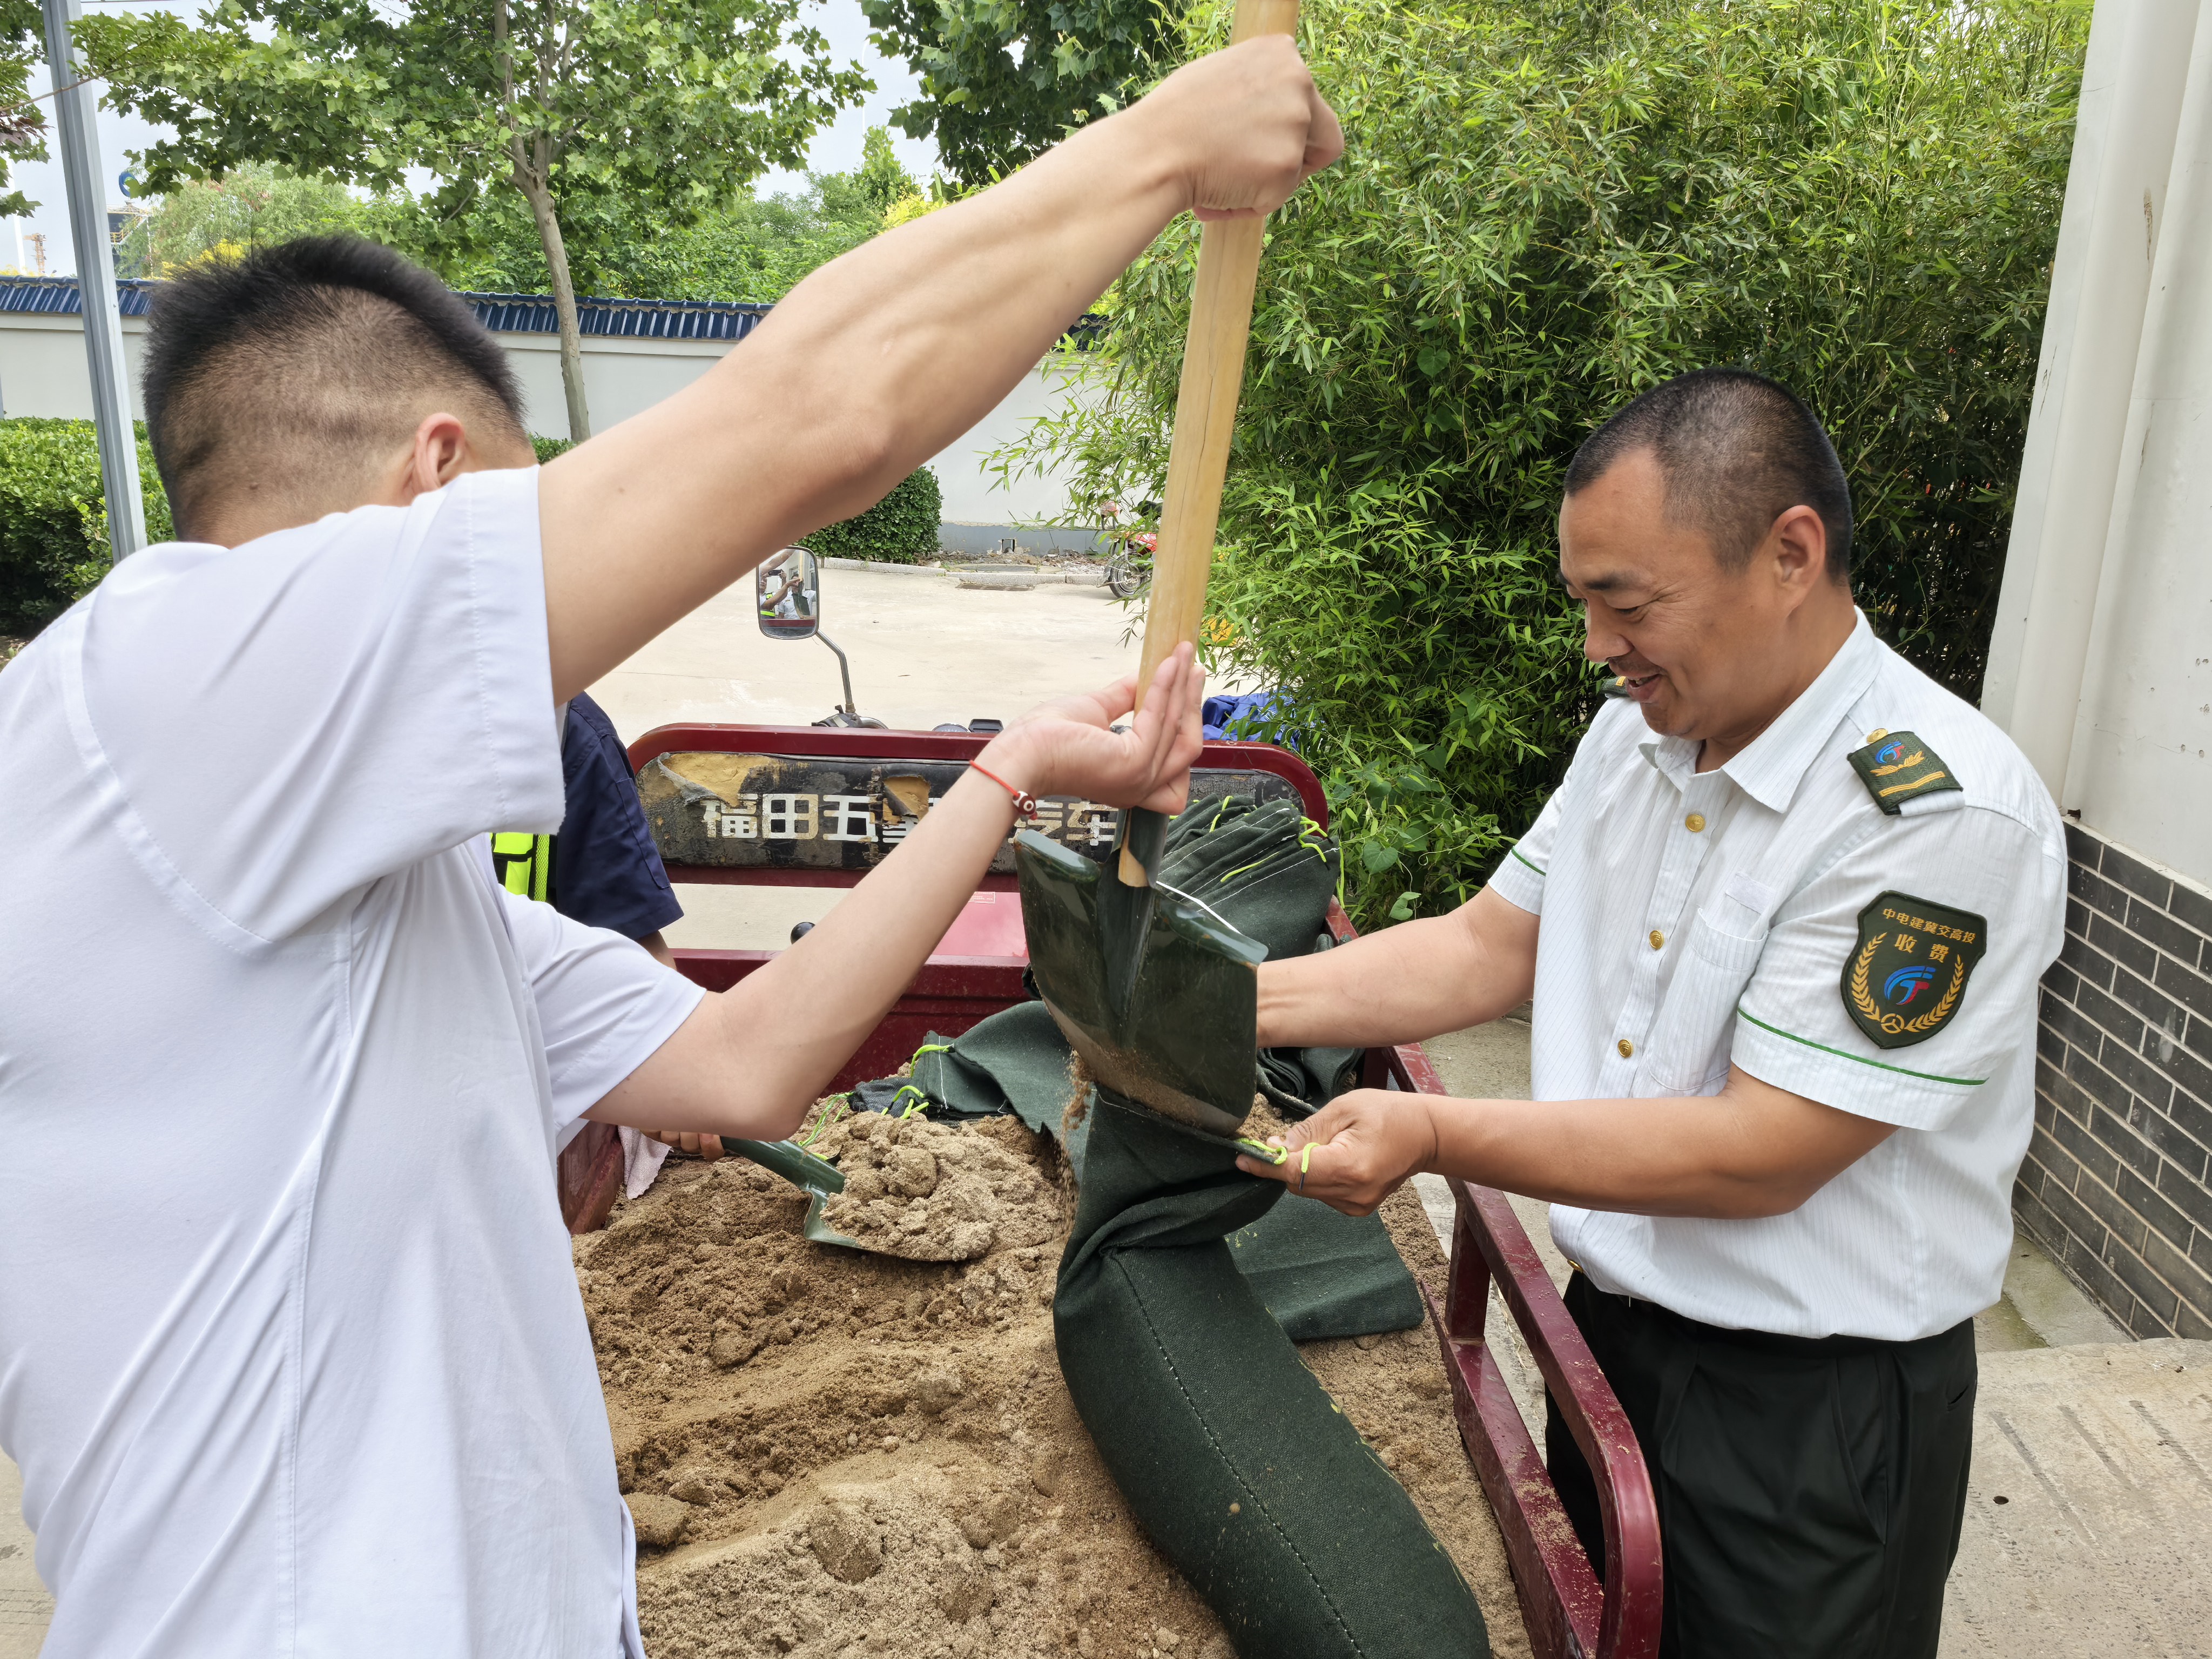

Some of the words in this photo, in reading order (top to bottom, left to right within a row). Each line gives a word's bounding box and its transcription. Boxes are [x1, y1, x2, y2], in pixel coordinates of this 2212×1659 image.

[1883, 908, 1976, 944] 中电建冀交高投
[1894, 934, 1950, 963] 收费
